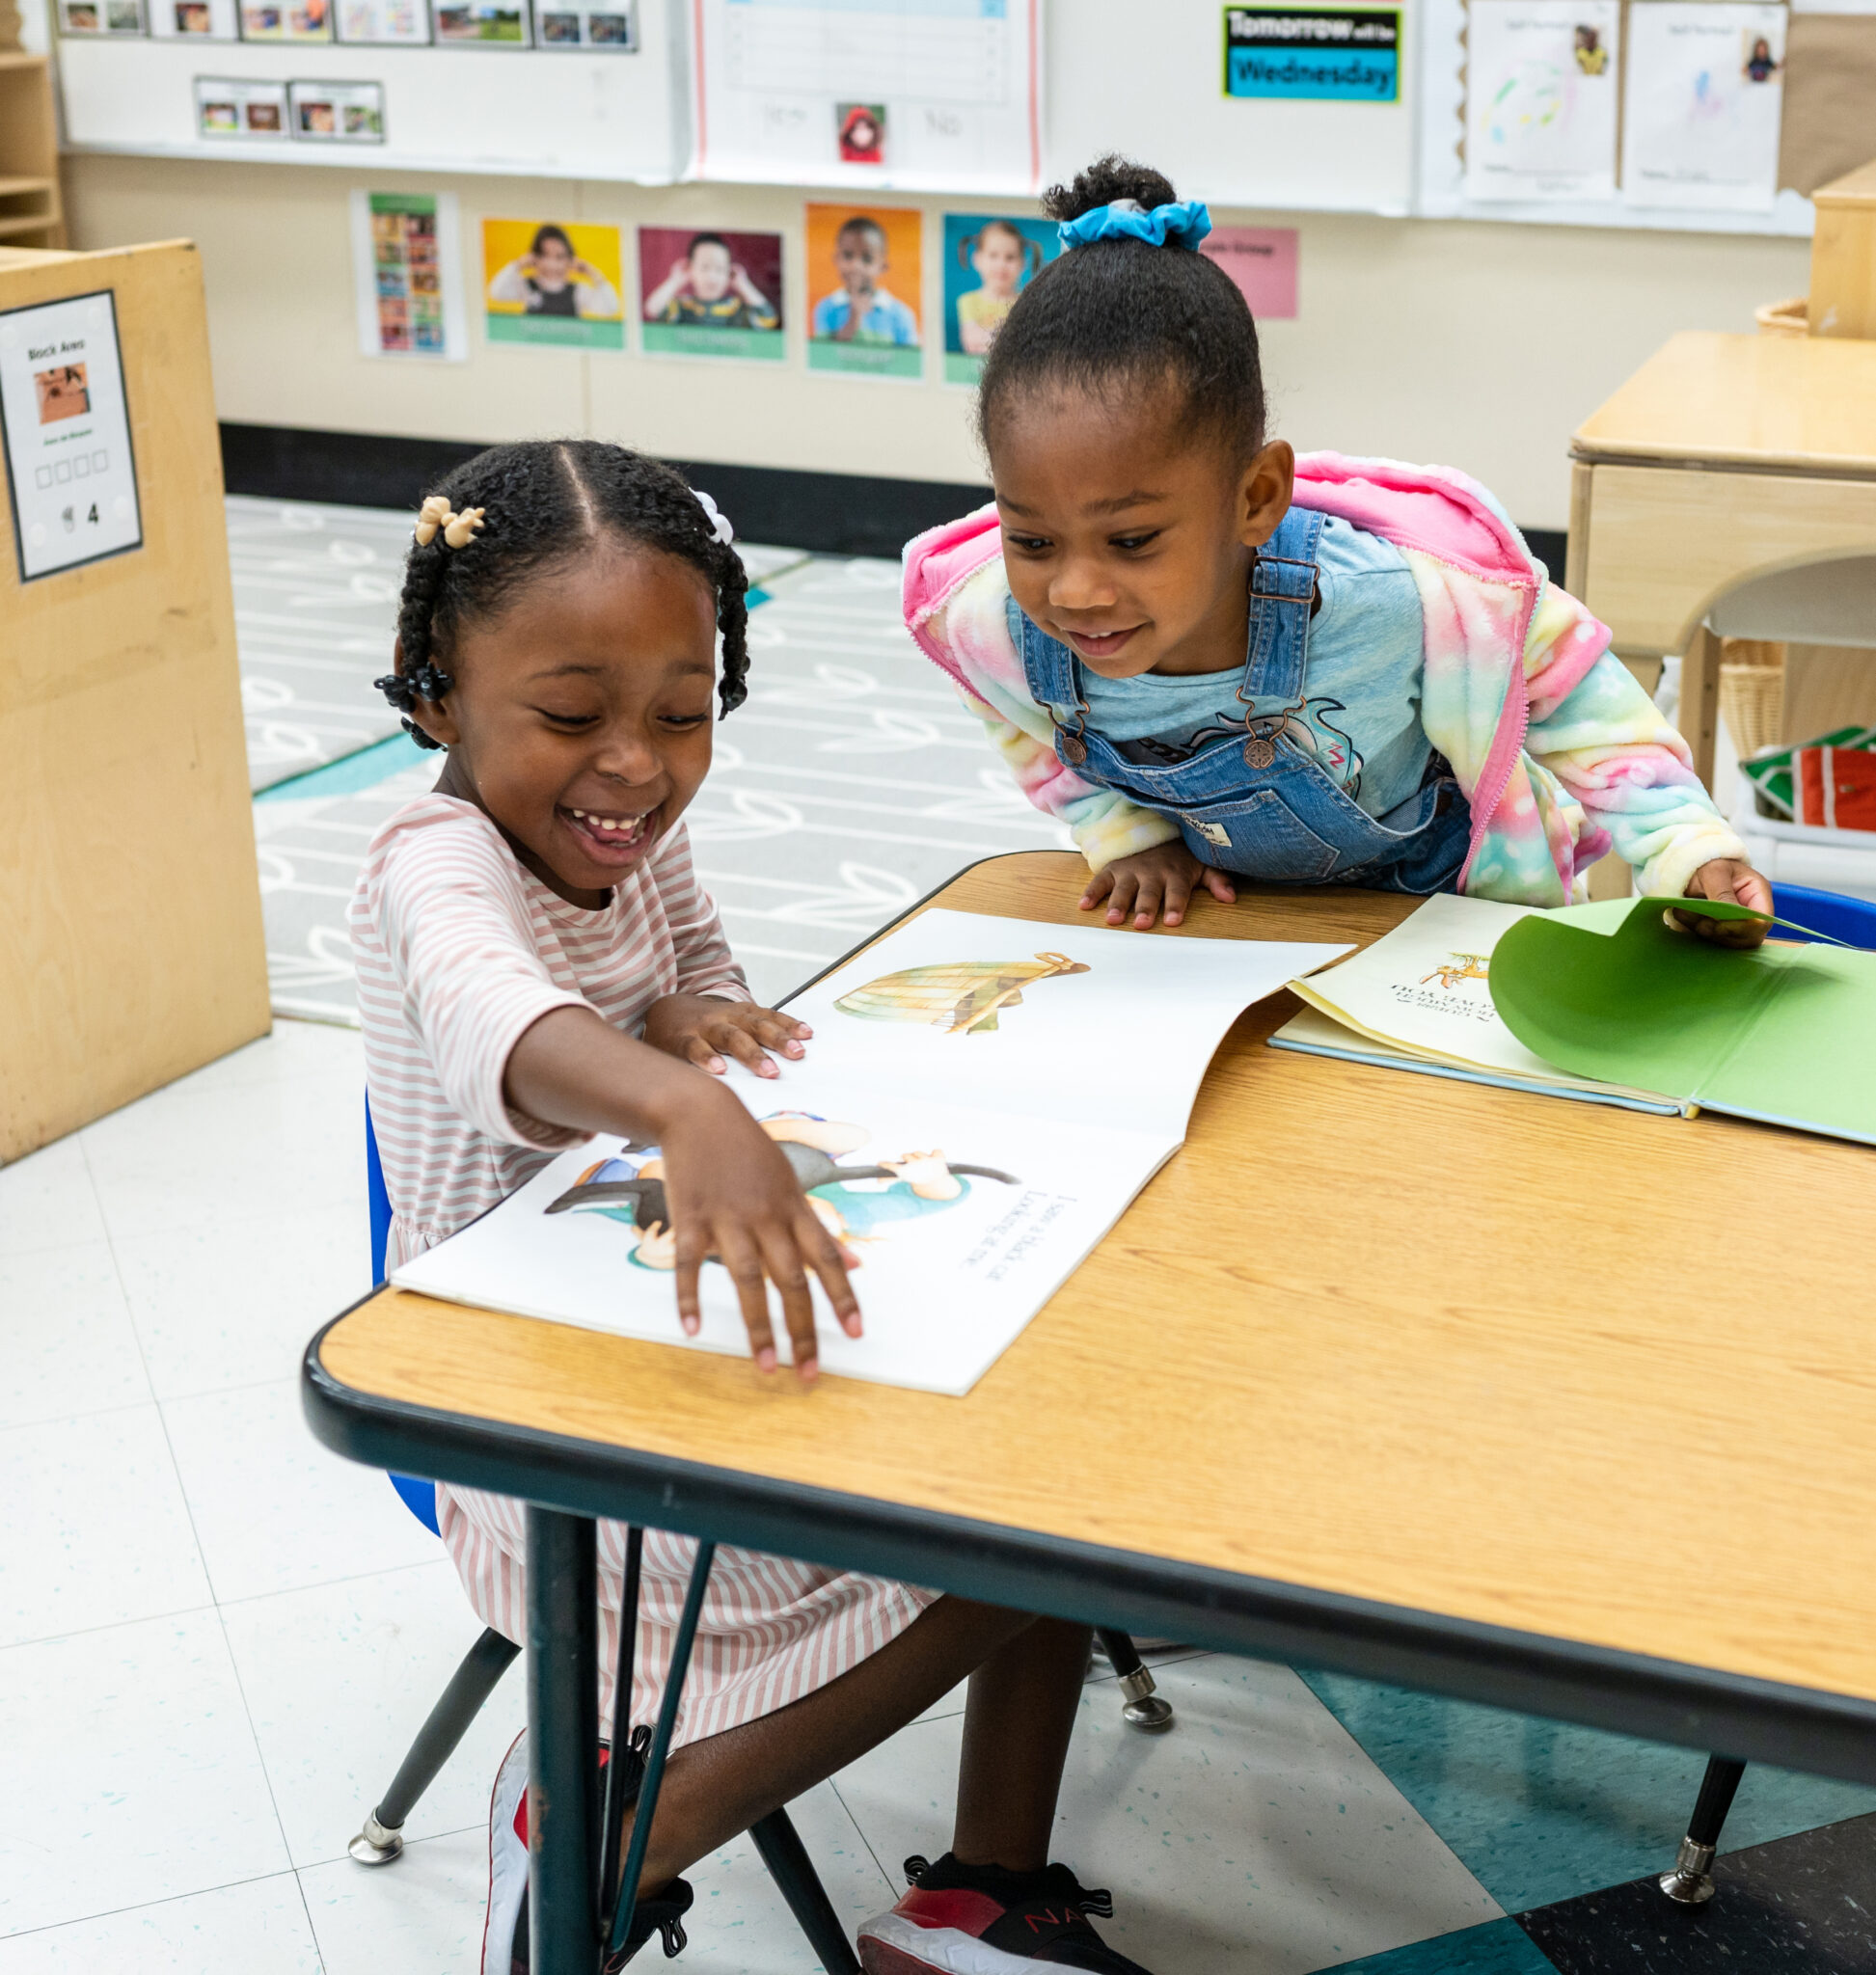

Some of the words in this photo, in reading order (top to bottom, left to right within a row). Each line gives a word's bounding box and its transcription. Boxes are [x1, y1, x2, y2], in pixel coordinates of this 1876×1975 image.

[1228, 10, 1354, 40] Tomorrow
[1379, 25, 1396, 41] be
[1234, 57, 1393, 95] Wednesday
[28, 343, 57, 362] Block
[61, 338, 85, 354] Area
[87, 501, 100, 525] 4
